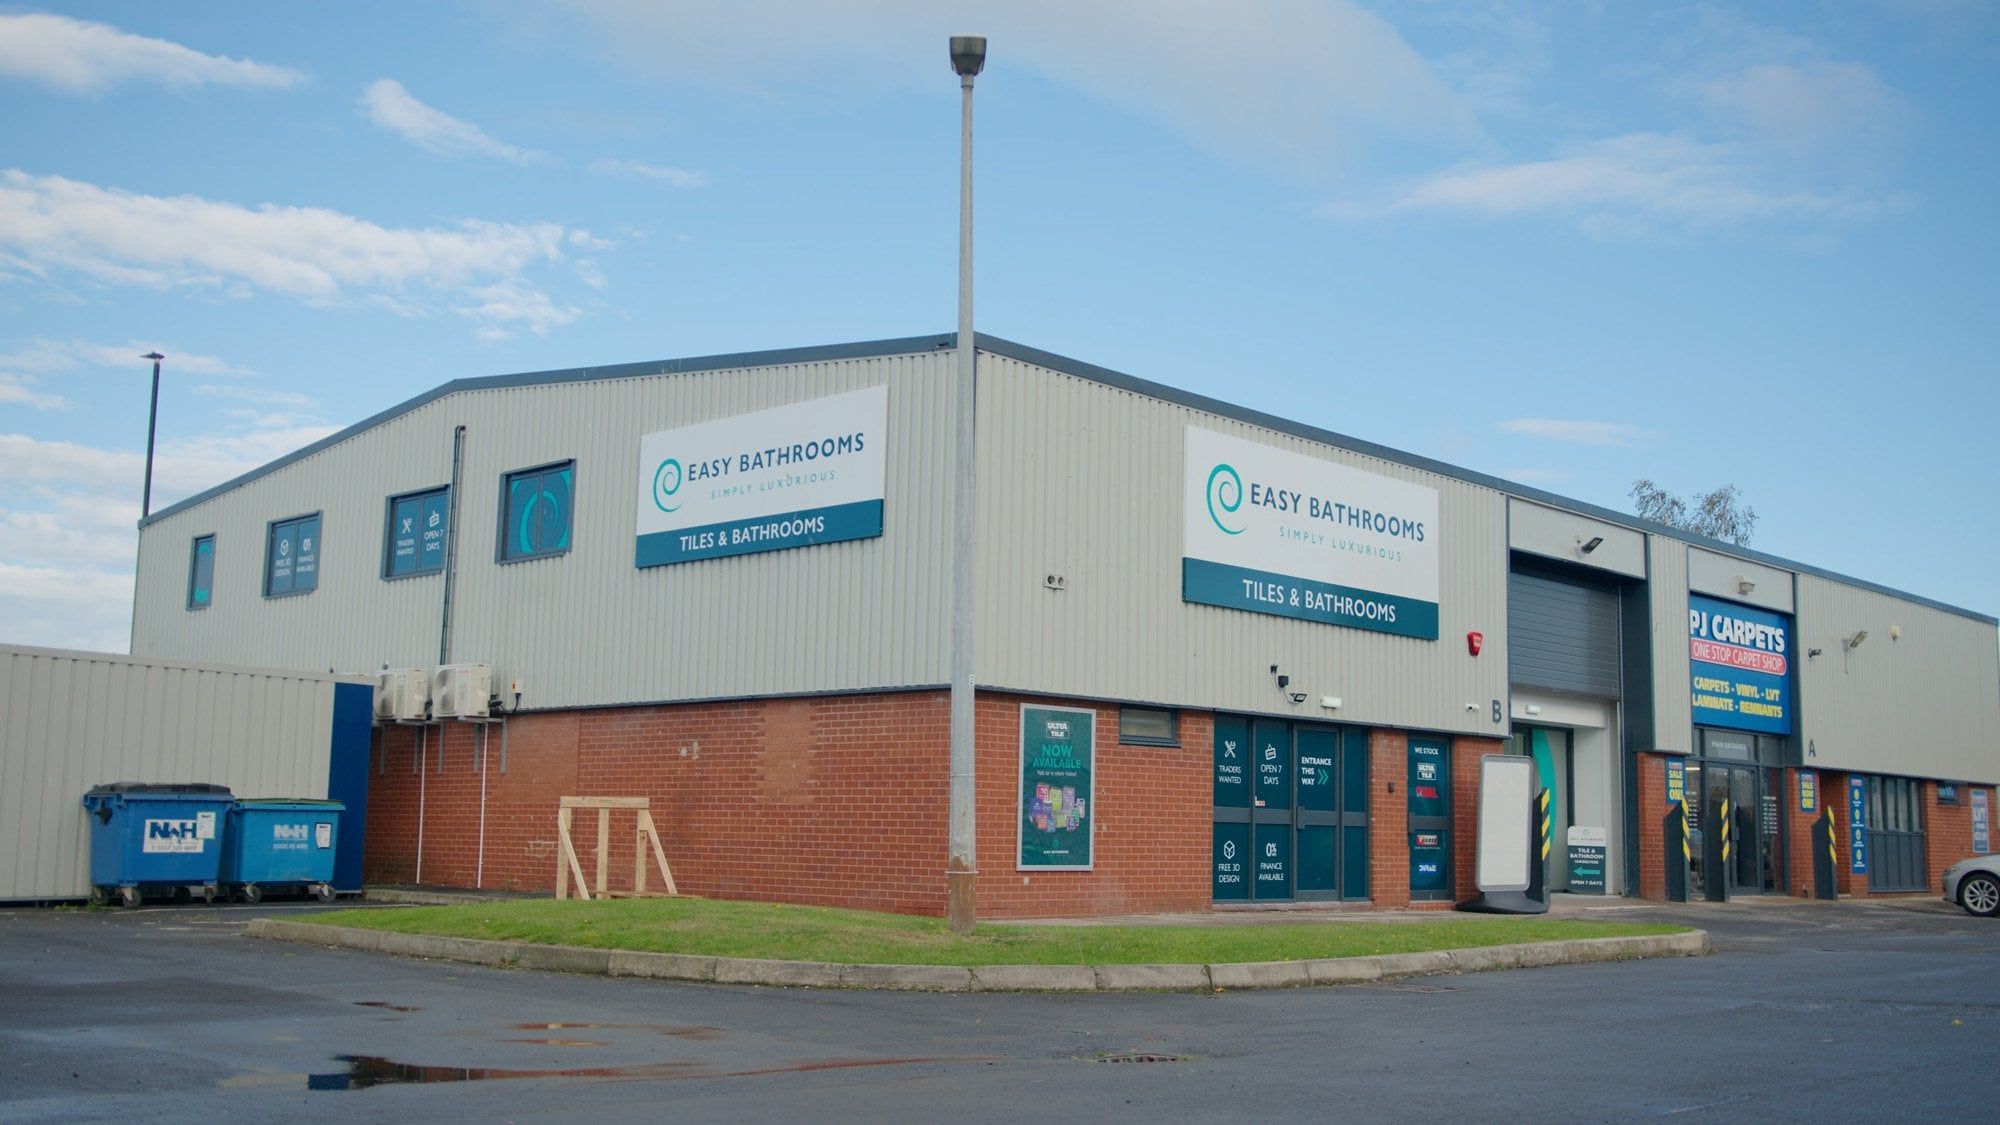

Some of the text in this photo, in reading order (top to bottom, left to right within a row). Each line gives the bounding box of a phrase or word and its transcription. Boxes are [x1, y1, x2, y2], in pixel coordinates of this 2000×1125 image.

[688, 433, 864, 481] EASY BATHROOMS
[711, 470, 835, 499] SIMPLY LUXURIOUS
[1251, 483, 1424, 542] EASY BATHROOMS
[425, 529, 444, 540] OPEN 7
[680, 516, 825, 551] TILES & BATHROOMS
[426, 542, 440, 551] DAYS
[1279, 527, 1401, 562] SIMPLY LUXURIOUS
[1242, 579, 1396, 623] TILES & BATHROOMS
[1690, 609, 1785, 653] PJ CARPETS
[1693, 642, 1782, 671] ONE STOP CARPET SHOP
[1693, 676, 1780, 701] CARPETS VINYL LVT
[1692, 693, 1782, 718] LAMINATE REMNANTS
[1492, 700, 1502, 724] B
[1047, 722, 1068, 730] ULTRA
[1042, 744, 1073, 757] NOW
[1423, 747, 1439, 755] STOCK
[1808, 738, 1816, 758] A
[1032, 758, 1082, 769] AVAILABLE
[1301, 757, 1332, 766] ENTRANCE
[1219, 765, 1241, 773] TRADERS
[1260, 764, 1282, 773] OPEN 7
[1301, 767, 1315, 775] THIS
[1218, 775, 1241, 784] WANTED
[1669, 770, 1683, 779] SALE
[1263, 776, 1279, 785] DAYS
[1218, 863, 1240, 871] FREE 3D
[1260, 862, 1282, 870] FINANCE
[1218, 874, 1240, 882] DESIGN
